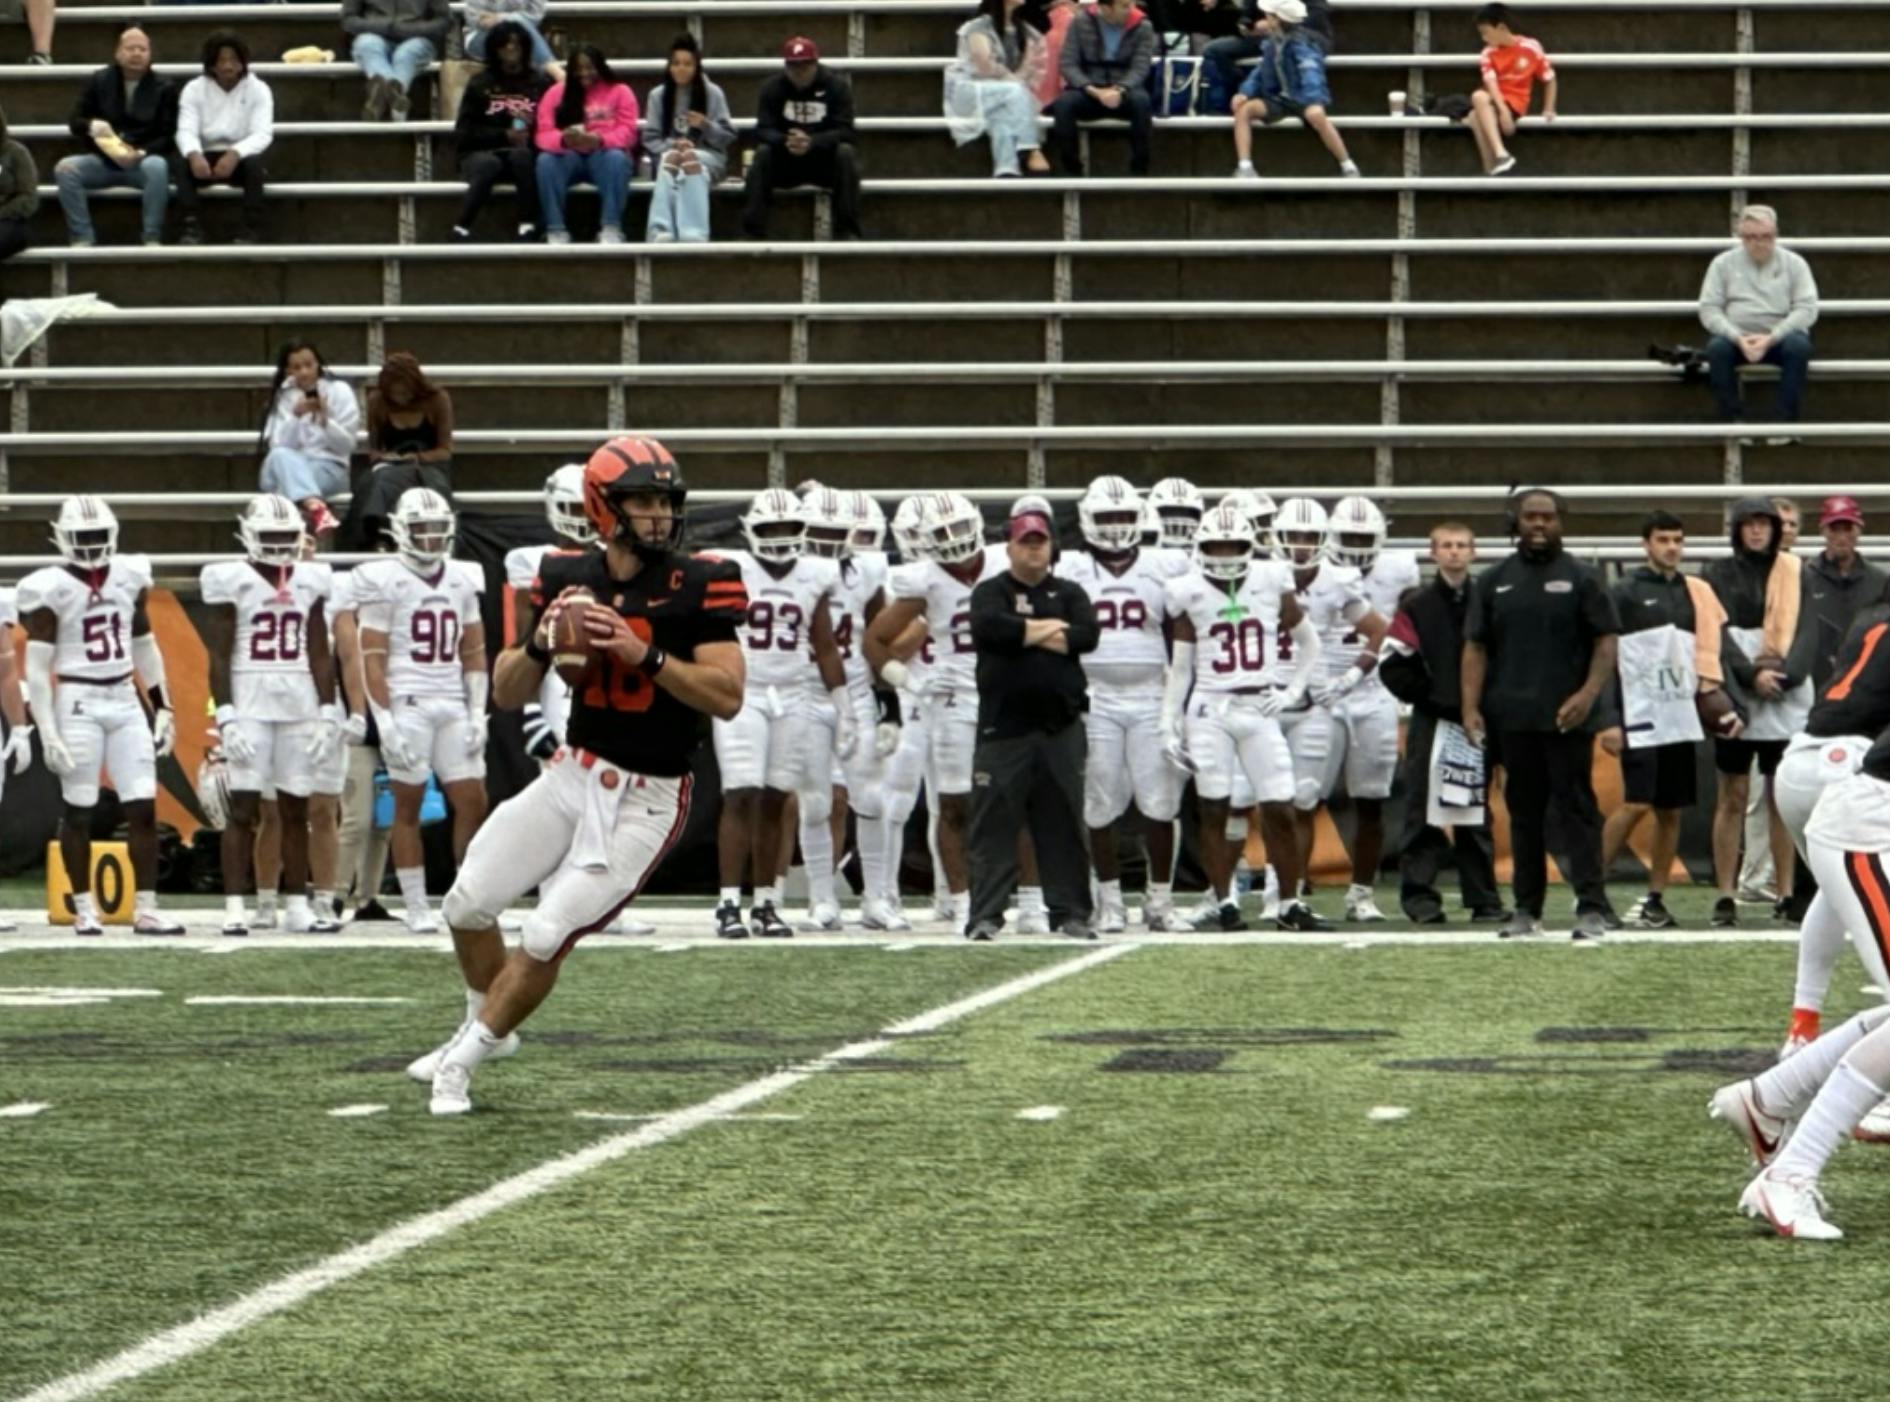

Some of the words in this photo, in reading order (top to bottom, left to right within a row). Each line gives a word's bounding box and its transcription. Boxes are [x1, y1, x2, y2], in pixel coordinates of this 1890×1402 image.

[670, 569, 684, 591] C
[82, 611, 125, 662] 51
[250, 611, 303, 660] 20
[410, 609, 458, 663] 90
[747, 601, 803, 651] 93
[1209, 618, 1264, 673] 30
[1824, 622, 1889, 701] 1
